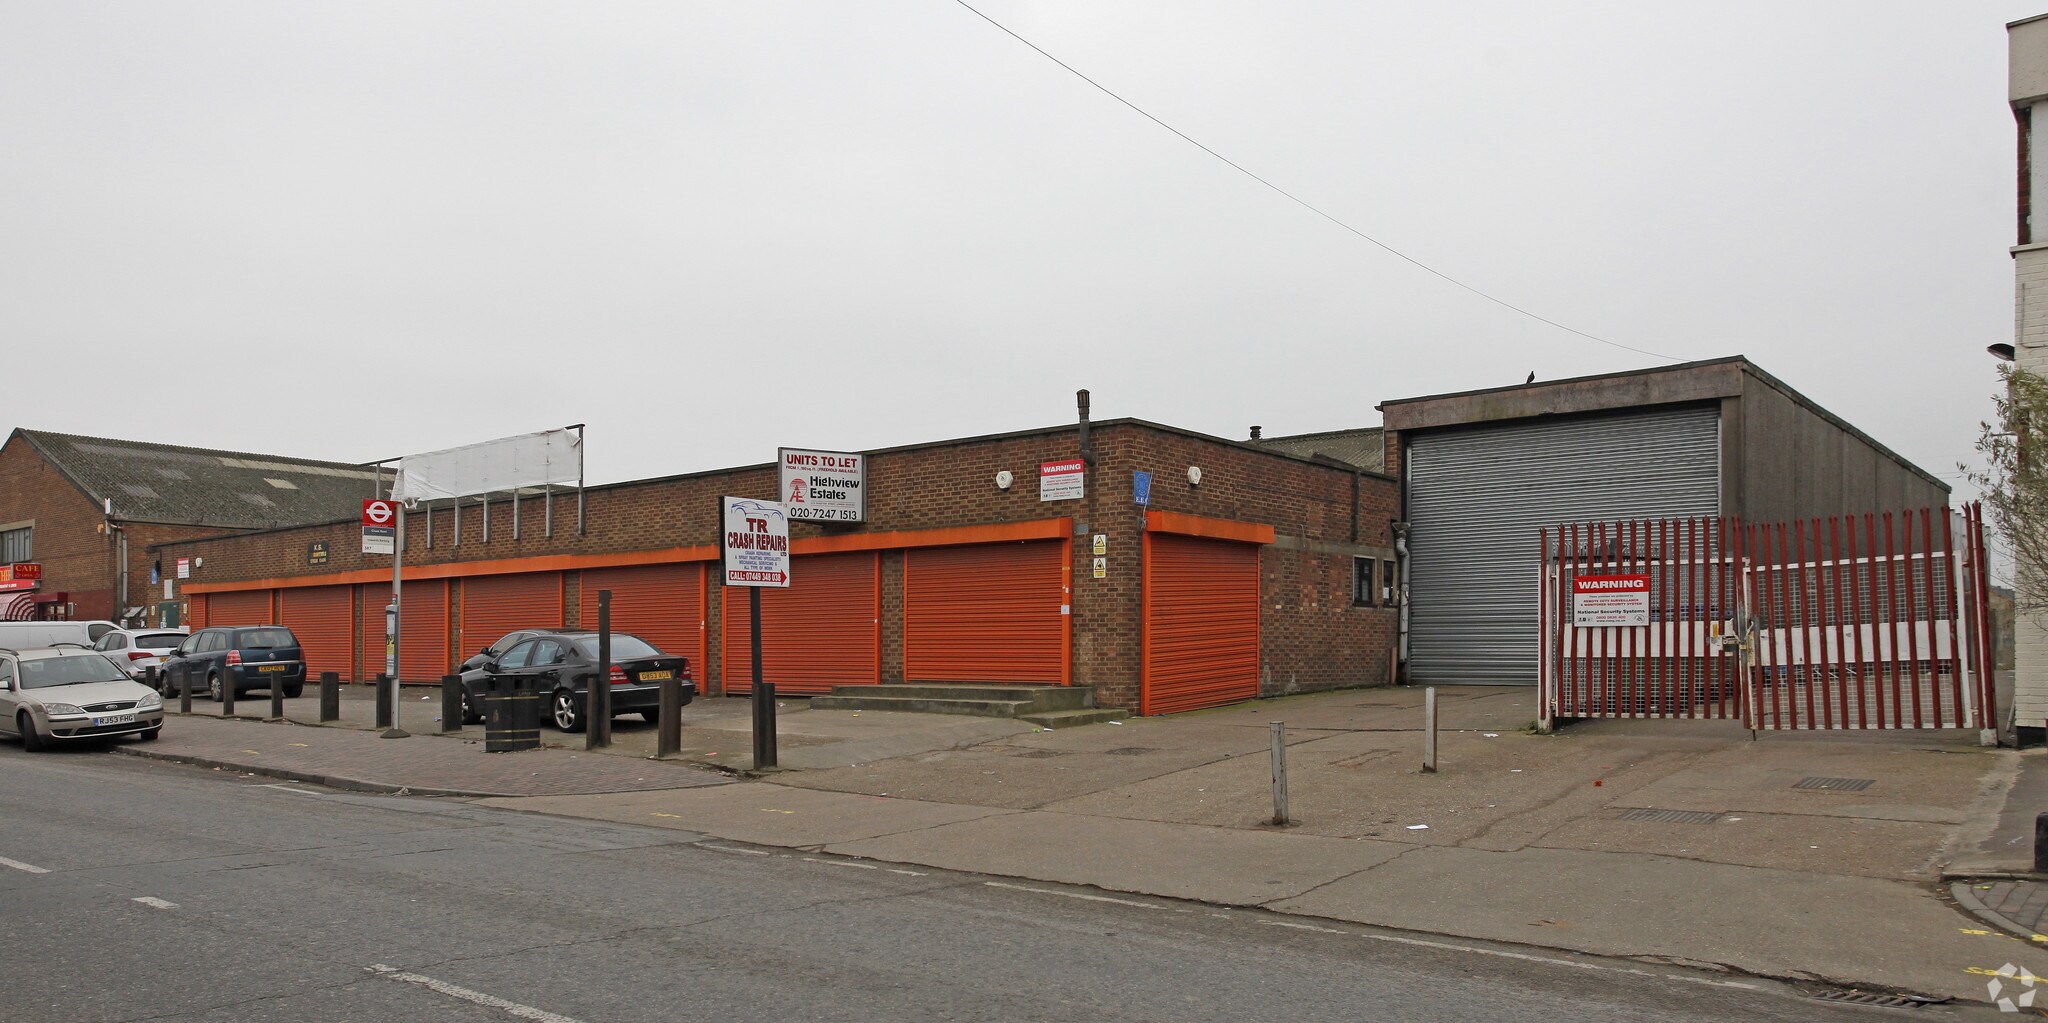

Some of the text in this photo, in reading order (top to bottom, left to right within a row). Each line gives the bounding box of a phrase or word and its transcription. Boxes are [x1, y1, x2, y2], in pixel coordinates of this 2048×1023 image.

[786, 454, 857, 468] UNITS TO LET
[1043, 464, 1081, 473] WARNING
[810, 476, 859, 488] Highview
[810, 488, 846, 500] Estates
[840, 510, 856, 520] 1513
[746, 518, 768, 533] TR
[728, 532, 787, 551] CRASH REPAIRS
[1578, 580, 1644, 590] WARNING
